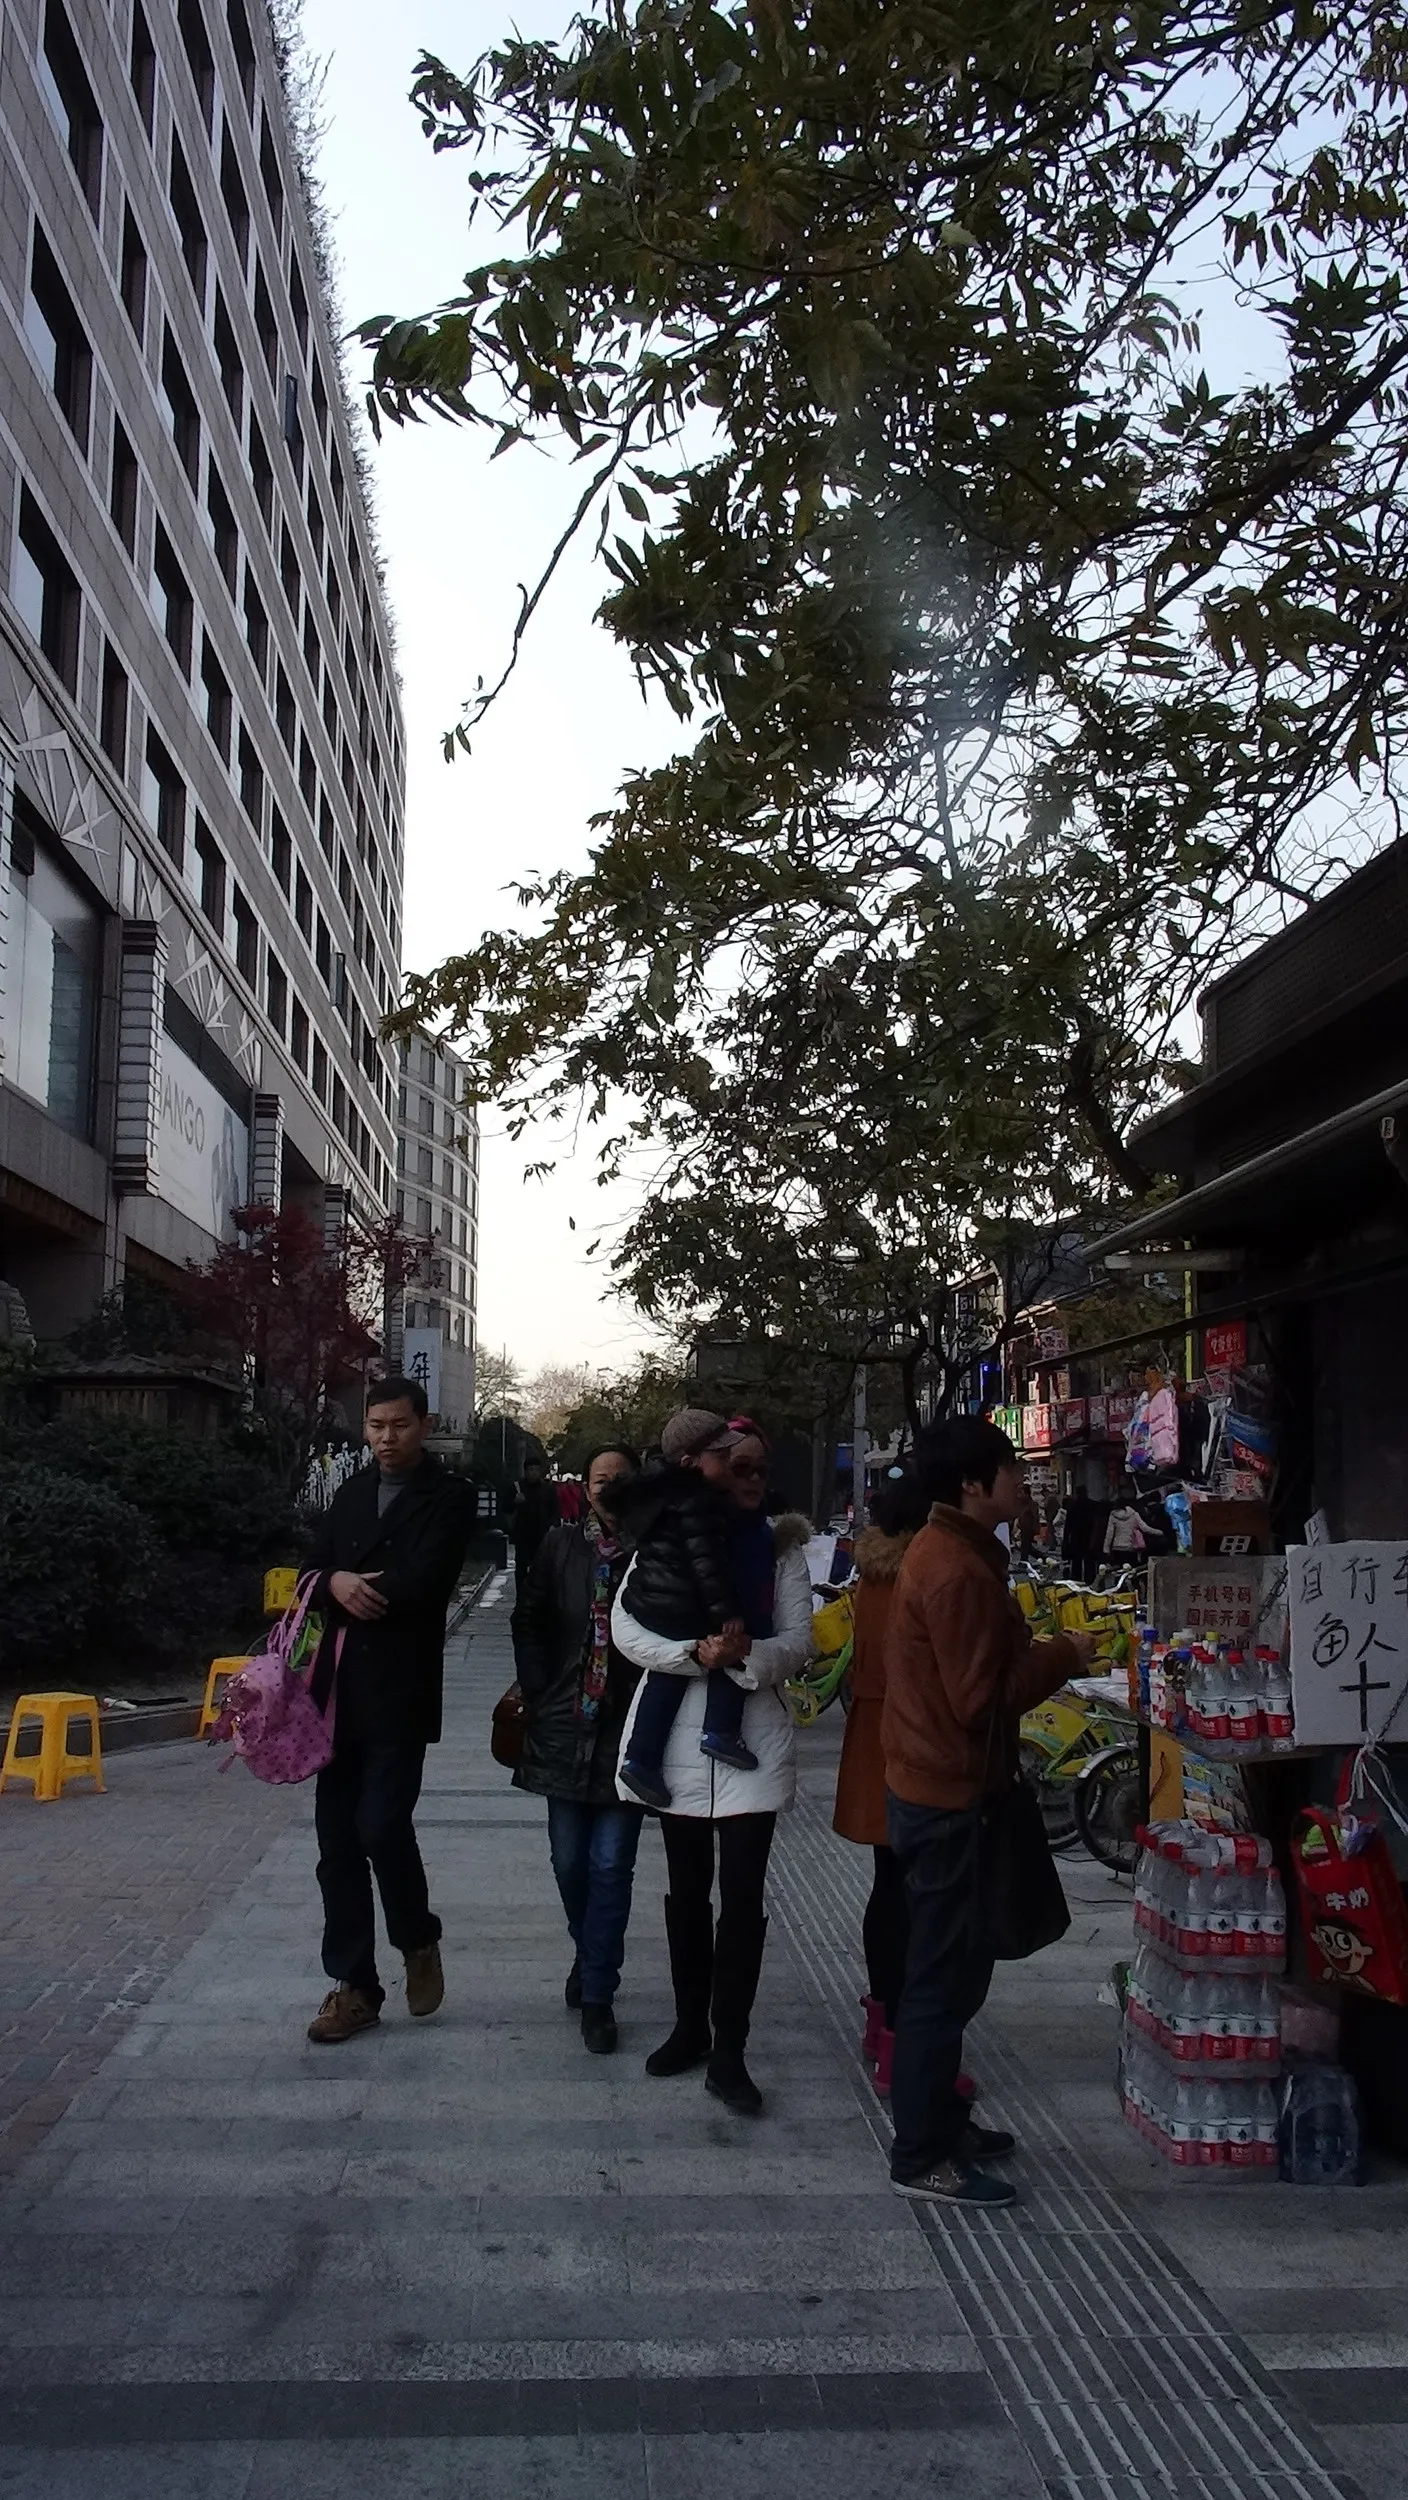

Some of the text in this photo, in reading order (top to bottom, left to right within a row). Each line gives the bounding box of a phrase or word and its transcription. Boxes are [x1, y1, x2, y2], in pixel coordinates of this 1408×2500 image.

[160, 1069, 204, 1154] ANGO
[1189, 1585, 1251, 1604] 手机号码
[1187, 1608, 1250, 1627] 国际开通
